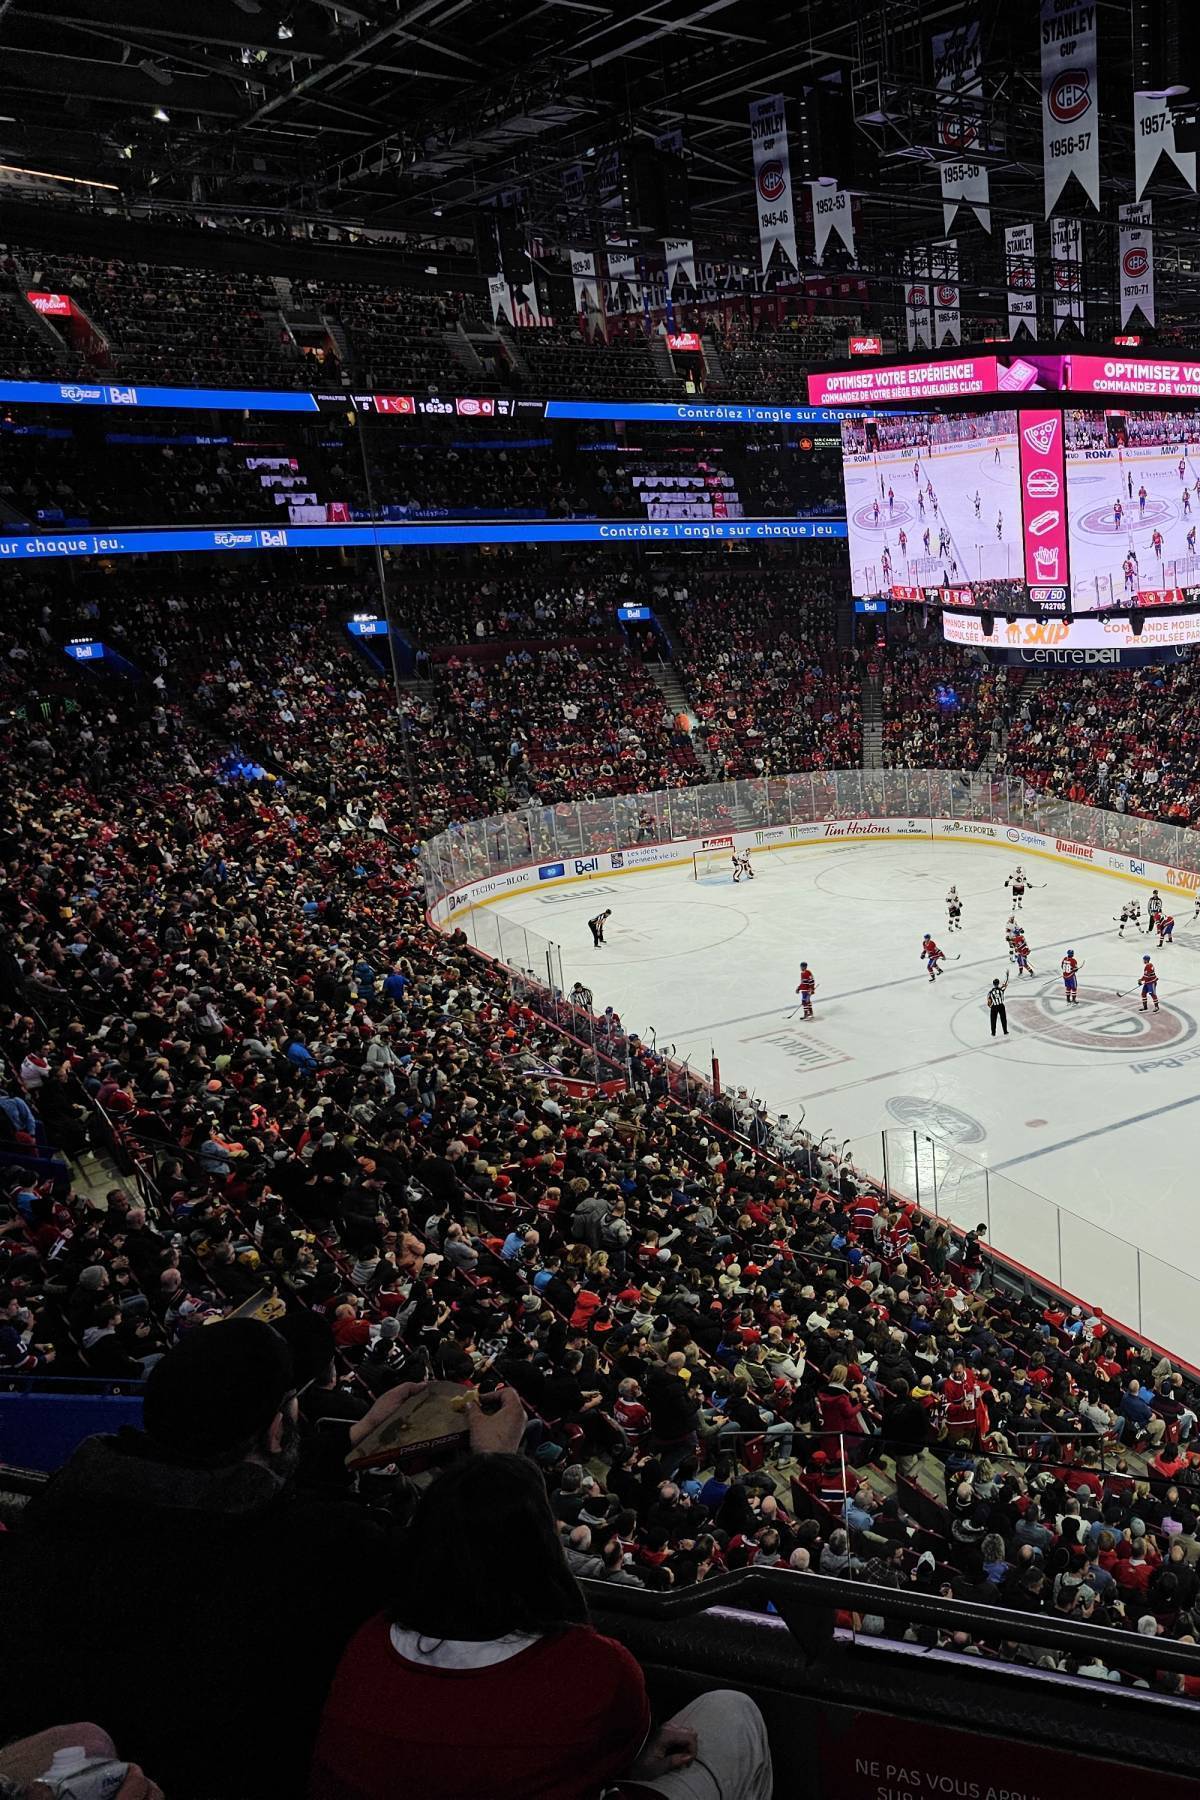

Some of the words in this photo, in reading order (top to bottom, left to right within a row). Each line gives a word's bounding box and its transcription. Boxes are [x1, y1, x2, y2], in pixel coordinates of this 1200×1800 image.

[1042, 7, 1094, 45] STANLEY
[1060, 41, 1077, 57] CUP
[752, 113, 784, 139] STANLEY
[1049, 133, 1091, 158] 1956-57
[943, 165, 979, 184] 1955-56
[816, 195, 845, 214] 1952-53
[1126, 206, 1144, 214] COUPE
[761, 210, 788, 228] 1945-46
[1011, 228, 1027, 238] COUPE
[1131, 232, 1142, 241] CUP
[1007, 238, 1033, 253] STANLEY
[1124, 285, 1148, 297] 1970-71
[1011, 302, 1033, 312] 1967-68
[826, 373, 874, 391] OPTIMISEZ
[875, 370, 907, 387] VOTRE
[908, 363, 974, 384] EXPÉRIENCE!
[1104, 362, 1179, 381] OPTIMISEZ
[821, 391, 860, 405] COMMANDEZ
[861, 391, 869, 401] DE
[870, 389, 891, 401] VOTRE
[891, 385, 910, 398] SIÈGE
[911, 387, 921, 397] EN
[922, 383, 959, 396] QUELQUES
[960, 380, 983, 393] CLICS!
[1093, 378, 1157, 393] COMMANDEZ
[1159, 383, 1171, 394] DE
[110, 388, 137, 404] Bell
[382, 399, 389, 410] 1
[419, 402, 453, 413] 16:29
[678, 407, 742, 418] Contrôlez
[748, 409, 787, 422] l'angle
[797, 412, 817, 420] sur
[1085, 450, 1113, 459] RONA
[261, 531, 287, 547] Bell
[599, 524, 669, 537] Contrôlez
[674, 524, 723, 539] l'angle
[729, 526, 751, 536] sur
[757, 525, 806, 538] chaque
[811, 524, 838, 537] jeu.
[26, 539, 88, 554] chaque
[93, 536, 125, 552] jeu.
[1033, 590, 1063, 600] 50/50
[864, 603, 877, 611] Bell
[1040, 602, 1065, 610] 74270$
[1171, 619, 1200, 630] MOBILE
[1022, 623, 1069, 645] SKIP
[1126, 632, 1184, 645] PROPULSÉE
[1186, 630, 1200, 641] PAR
[76, 647, 92, 658] Bell
[824, 823, 847, 836] Tim
[847, 821, 890, 835] Hortons
[1055, 840, 1094, 859] Qualinet
[575, 857, 599, 874] Bell
[1130, 860, 1145, 875] Bell
[855, 1758, 880, 1778] NE
[886, 1764, 921, 1786] PAS
[926, 1773, 980, 1799] VOUS
